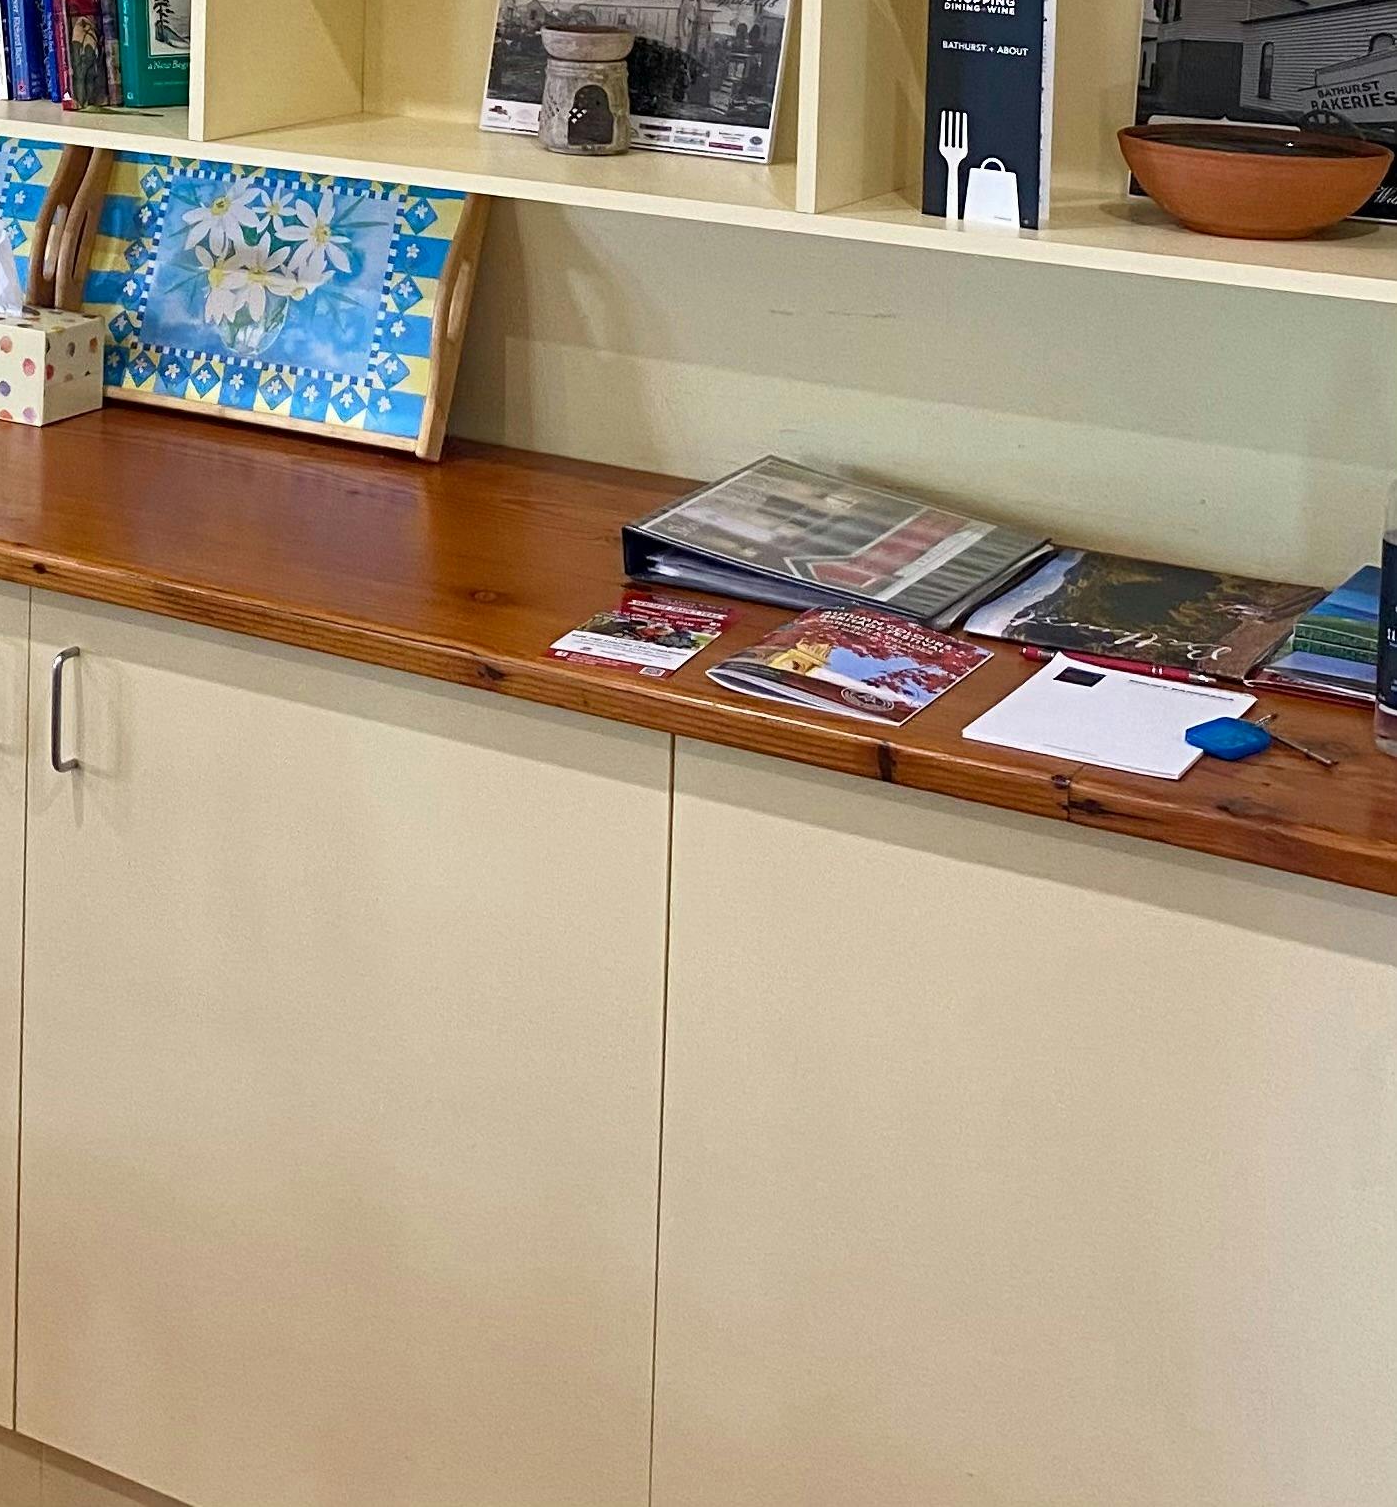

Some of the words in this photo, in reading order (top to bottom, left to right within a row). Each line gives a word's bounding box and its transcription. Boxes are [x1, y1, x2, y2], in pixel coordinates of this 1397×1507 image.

[944, 2, 981, 13] DINING
[986, 4, 1016, 16] WINE
[13, 15, 21, 46] Richard
[14, 46, 22, 66] Bach
[942, 40, 988, 53] BATHURST
[996, 45, 1029, 57] ABOUT
[153, 61, 172, 71] New
[1317, 80, 1381, 100] BATHURST
[1310, 90, 1397, 111] BAKERIES
[823, 609, 885, 628] AUTUMN
[886, 623, 953, 651] COLOURS
